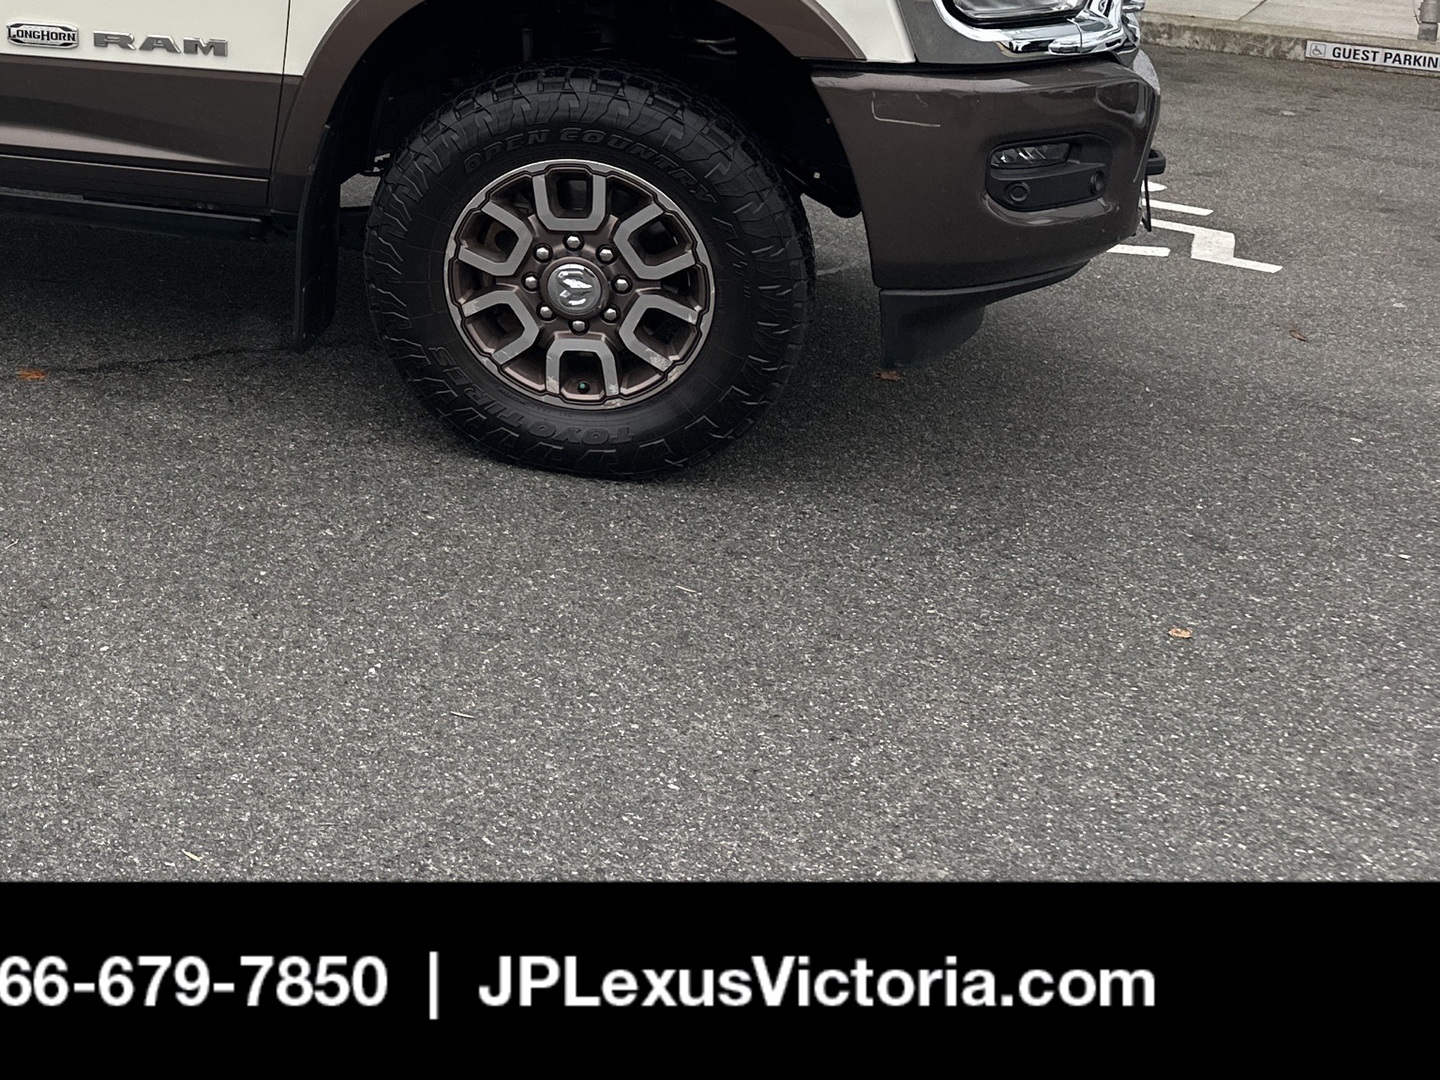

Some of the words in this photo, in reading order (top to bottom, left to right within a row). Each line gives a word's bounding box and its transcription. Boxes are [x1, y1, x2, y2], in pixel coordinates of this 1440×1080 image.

[6, 24, 77, 42] LONGHORN
[92, 30, 229, 58] RAM
[1332, 46, 1380, 63] GUEST
[1383, 51, 1440, 69] PARKIN
[463, 128, 553, 174] OPEN
[558, 126, 718, 205] COUNTRY
[529, 420, 635, 446] TOYO
